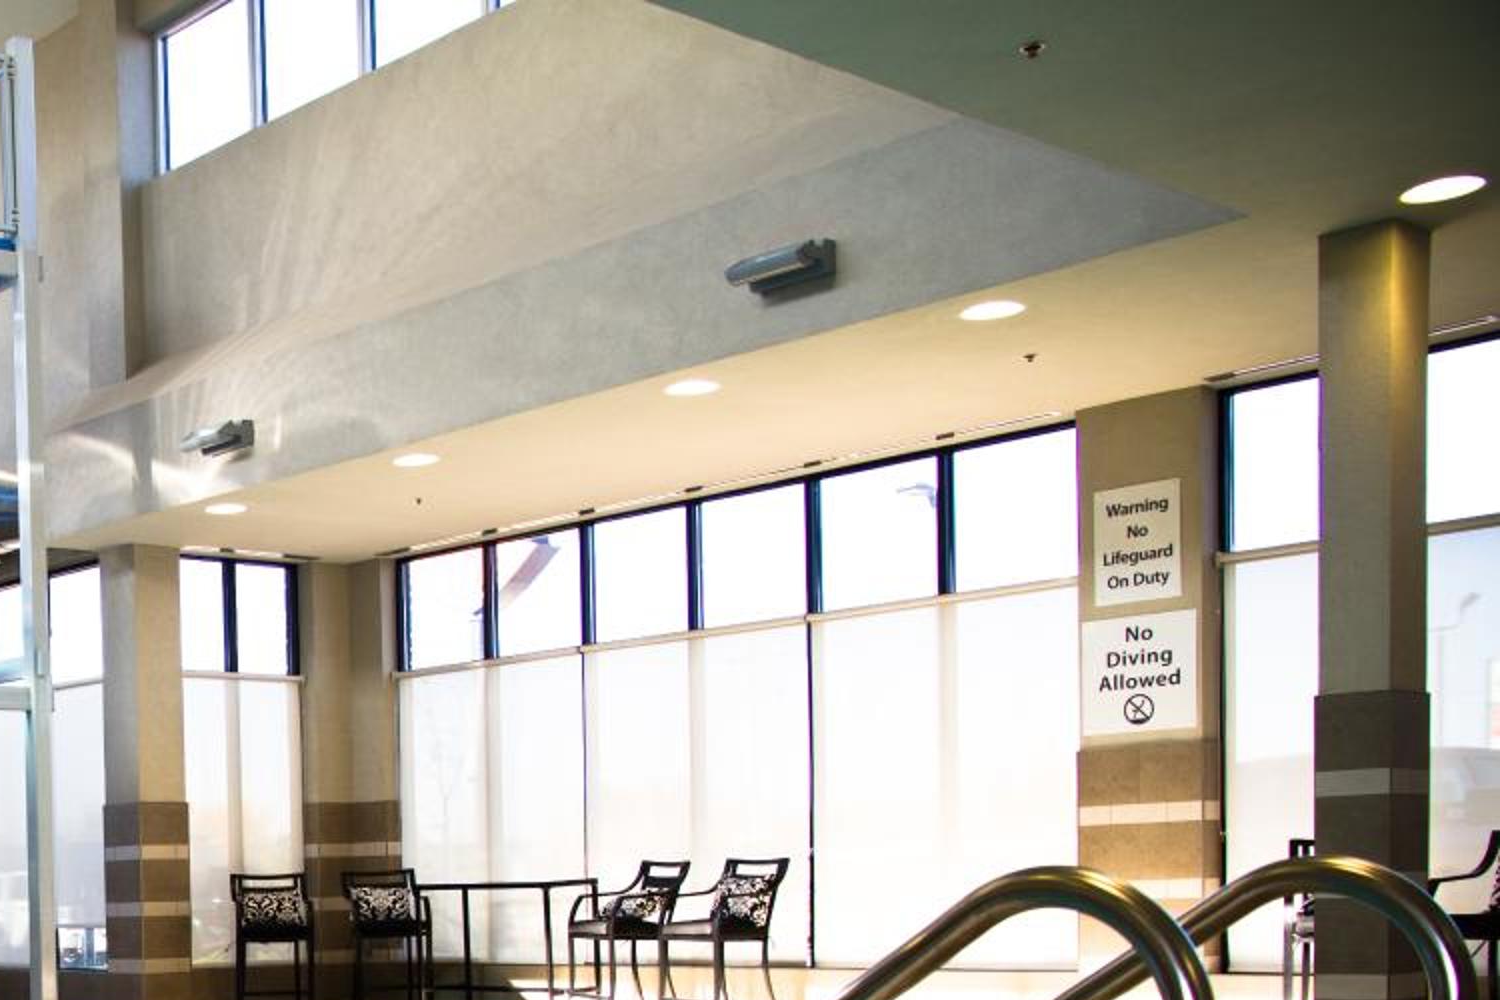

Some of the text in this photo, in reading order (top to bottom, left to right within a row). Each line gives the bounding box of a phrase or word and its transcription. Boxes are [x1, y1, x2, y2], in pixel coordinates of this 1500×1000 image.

[1106, 498, 1169, 518] Warning
[1127, 524, 1149, 539] No
[1103, 543, 1173, 567] Lifeguard
[1107, 570, 1171, 589] On Duty
[1125, 626, 1153, 642] No
[1107, 648, 1173, 668] Diving
[1099, 667, 1181, 692] Allowed
